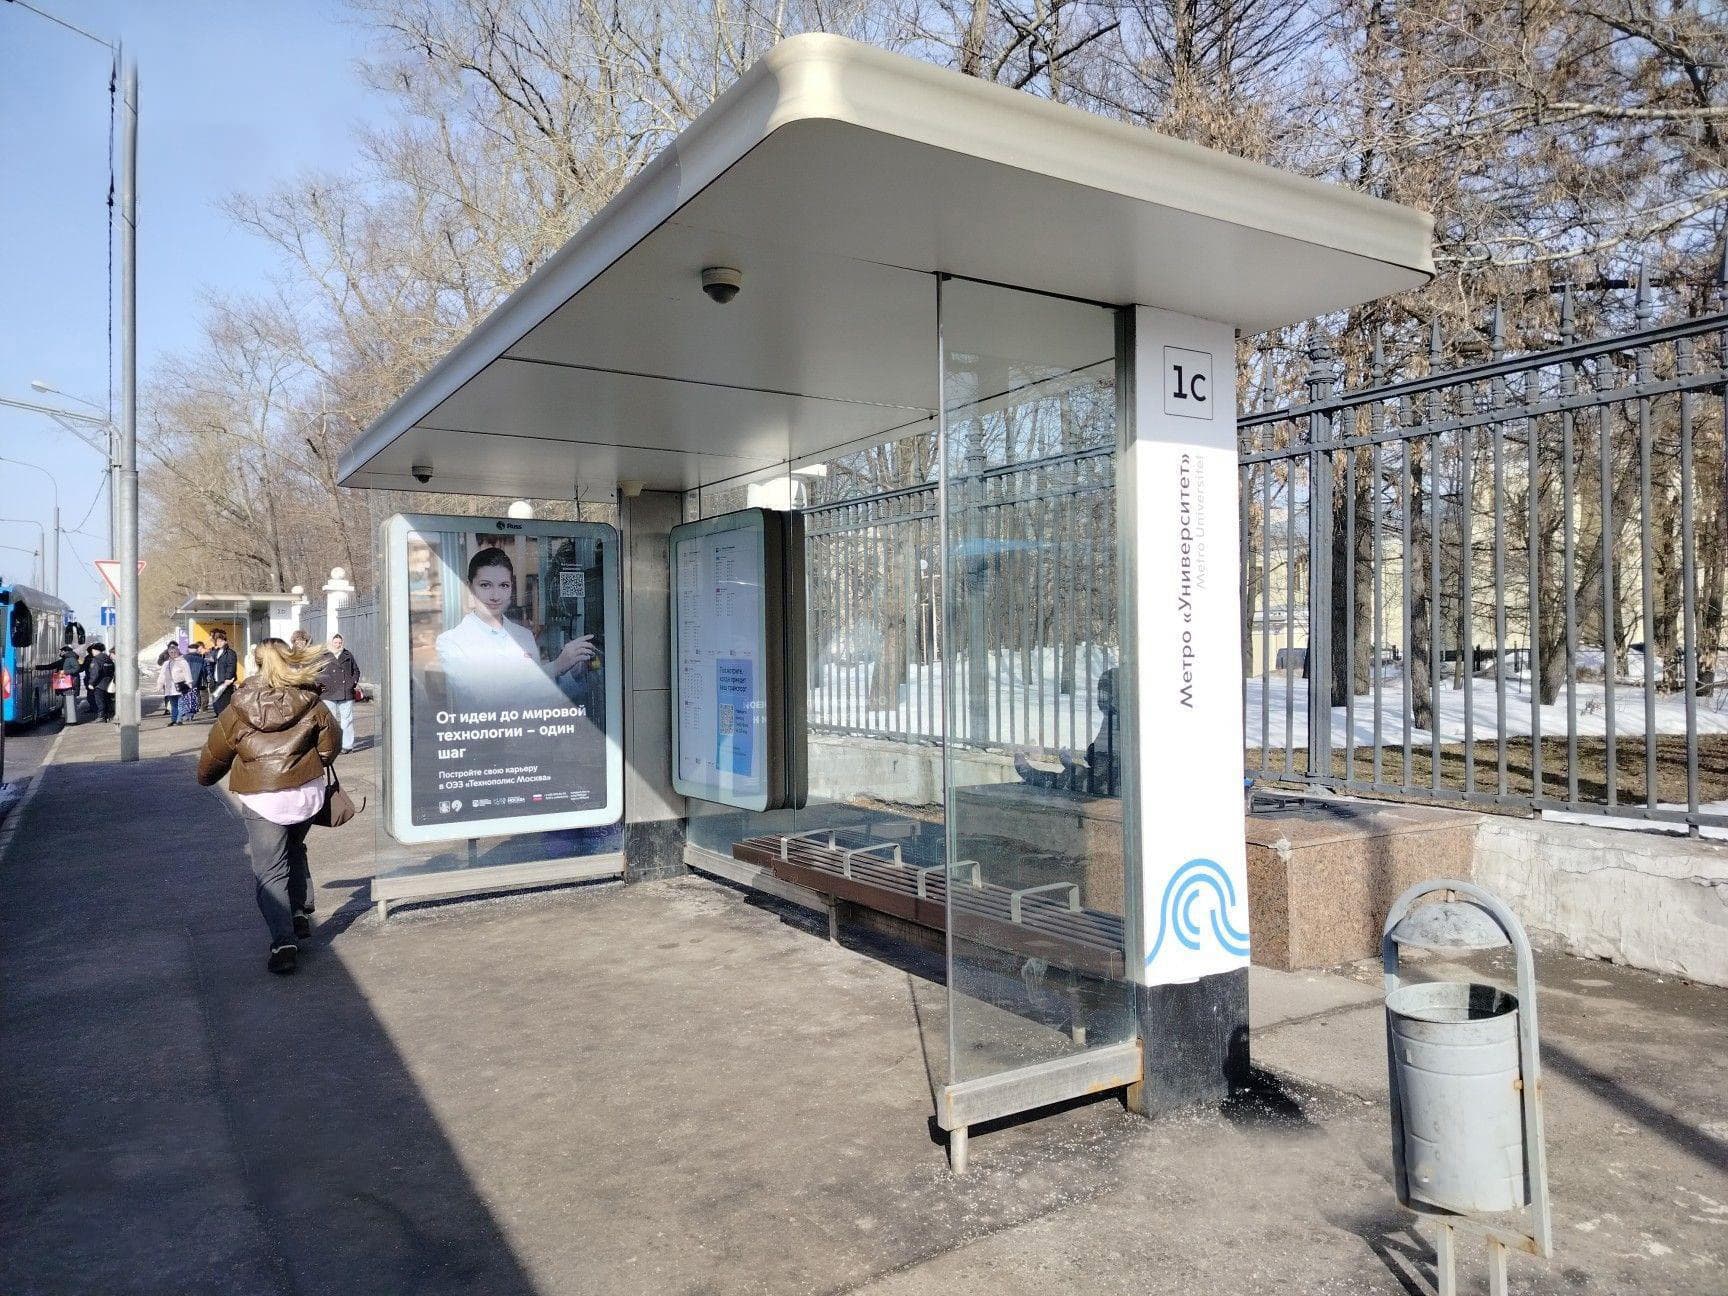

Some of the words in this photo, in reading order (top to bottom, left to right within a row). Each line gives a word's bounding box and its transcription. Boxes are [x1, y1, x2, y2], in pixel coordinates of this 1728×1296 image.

[1178, 453, 1193, 623] «Университет»
[1195, 542, 1206, 590] Metro
[1180, 630, 1195, 709] Метро
[436, 711, 456, 724] От
[460, 711, 497, 724] идеи
[500, 710, 519, 722] до
[522, 704, 587, 721] мировой
[436, 727, 523, 742] технологии
[539, 724, 575, 736] один
[438, 748, 467, 759] шаг
[438, 769, 482, 780] Постройте
[484, 767, 504, 775] свою
[505, 765, 538, 774] карьеру
[446, 780, 464, 789] ОЭЗ
[465, 776, 516, 788] «Технополис
[516, 774, 552, 784] Москва»
